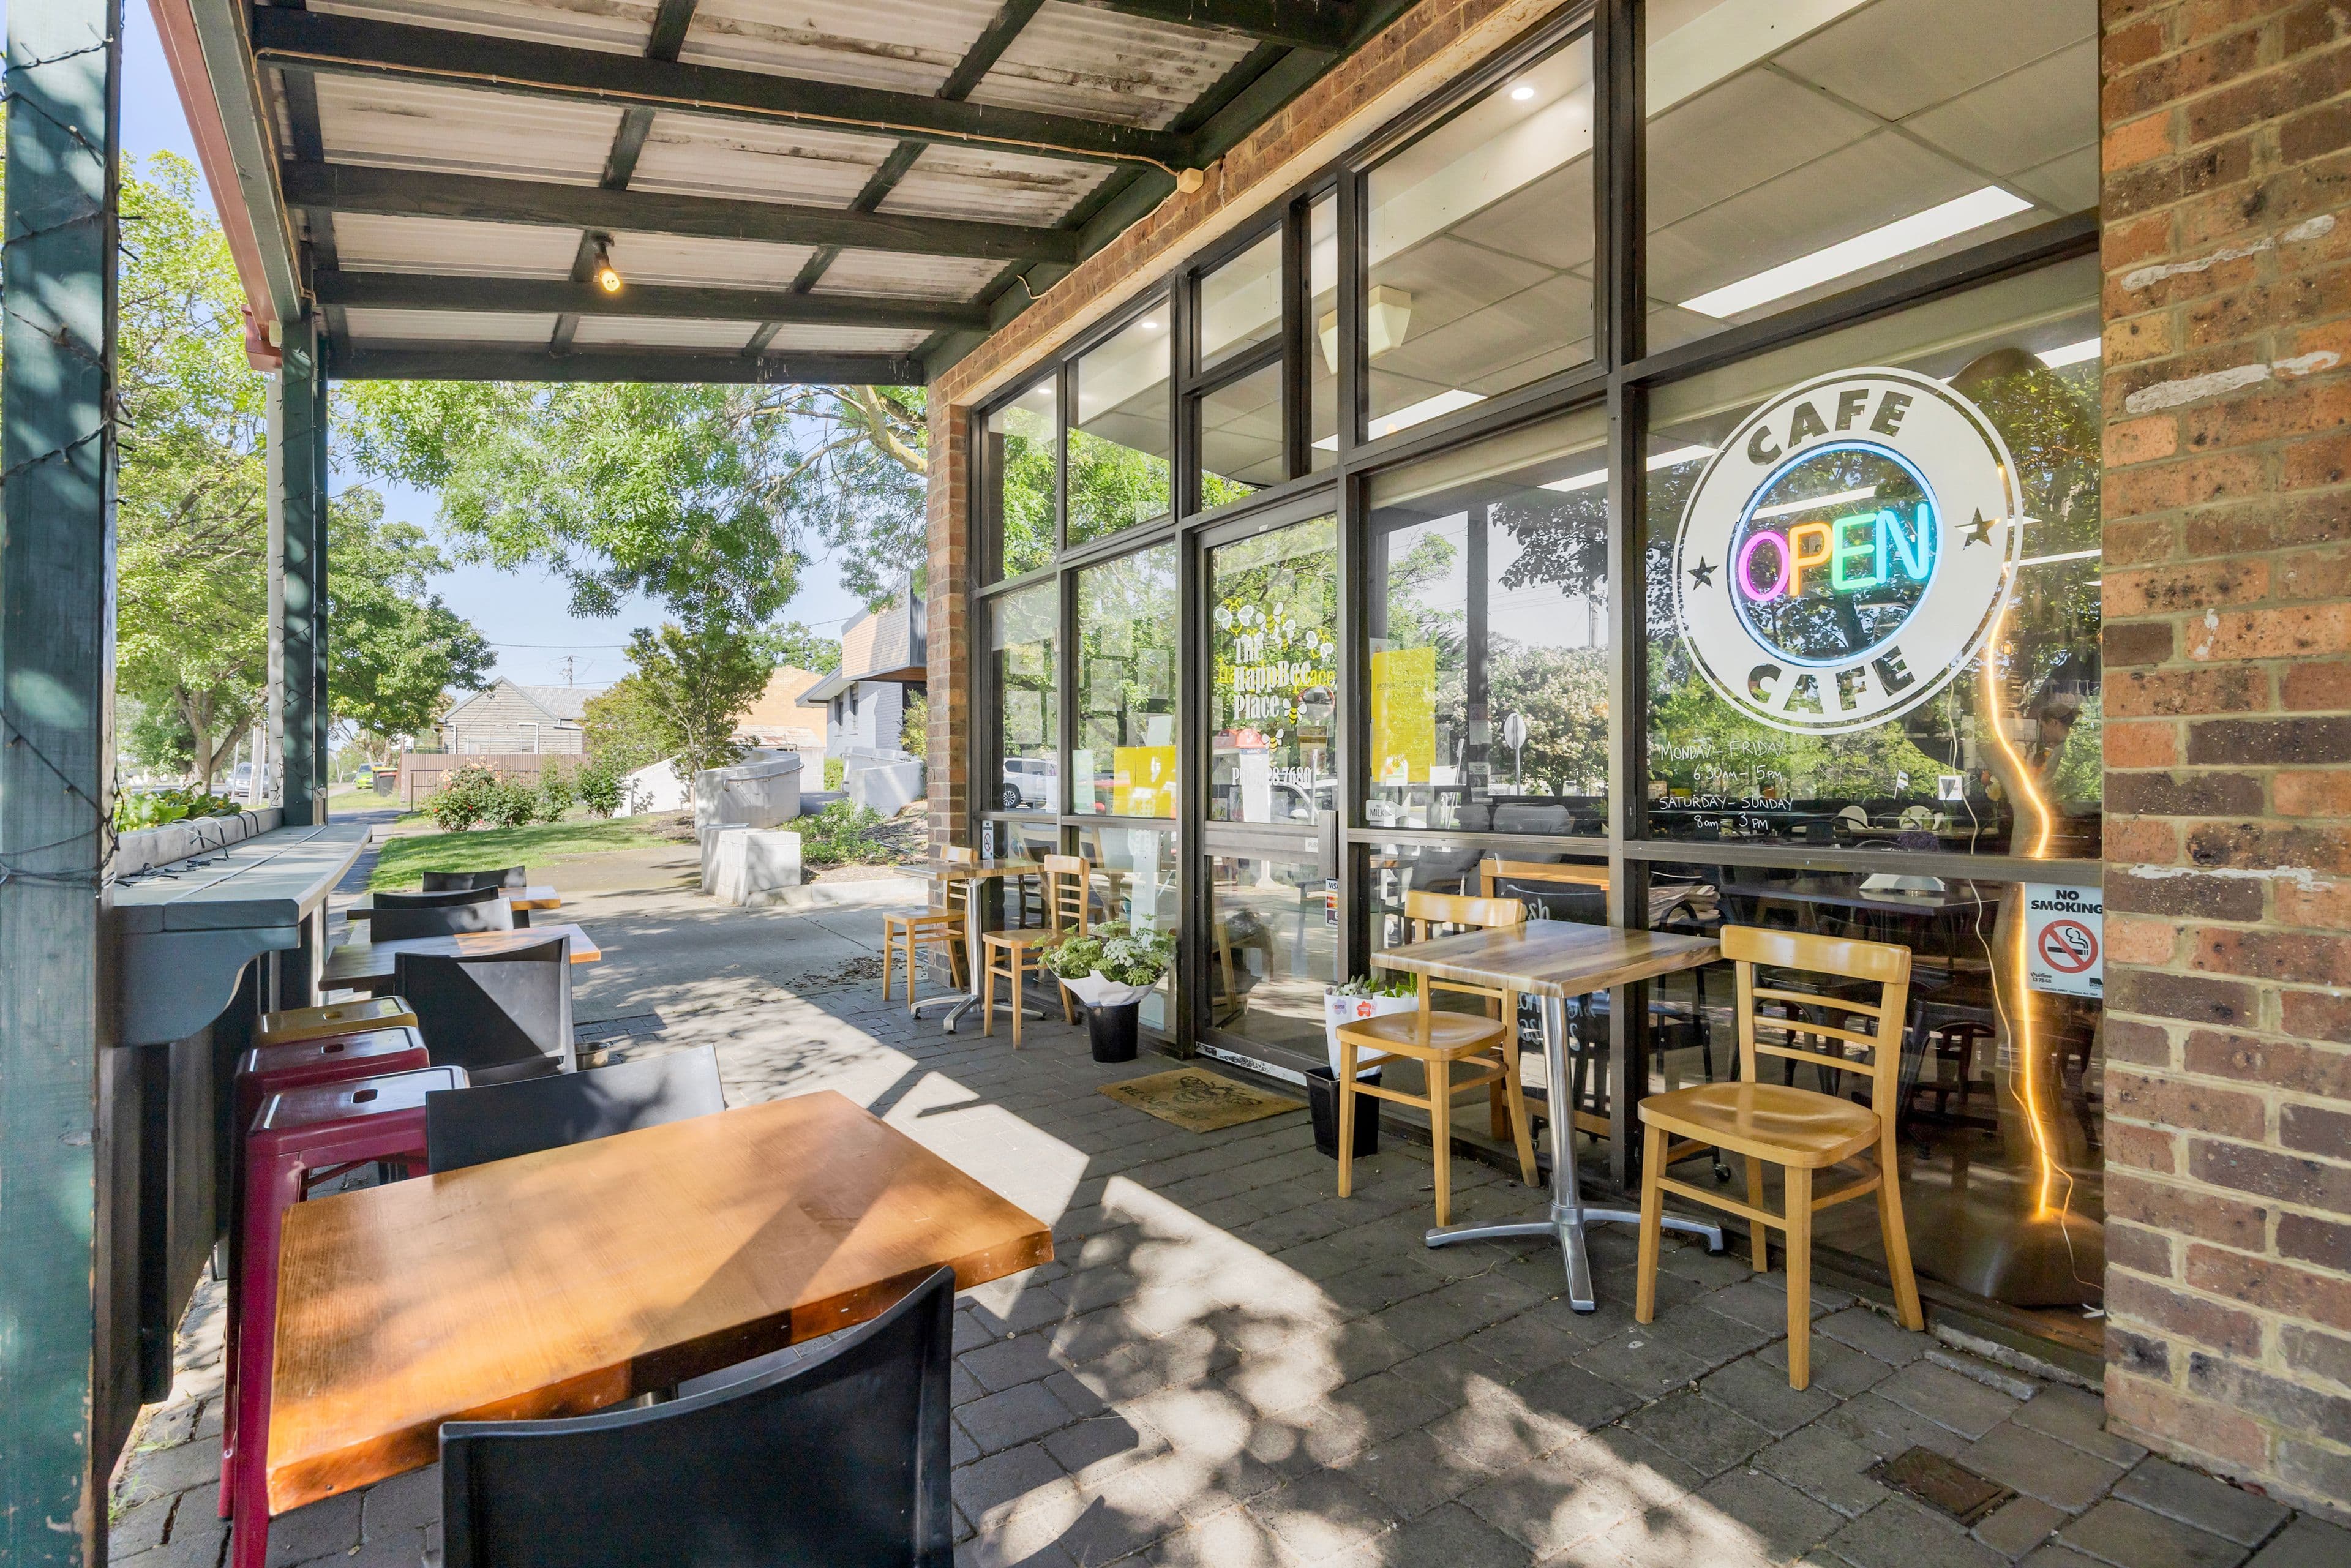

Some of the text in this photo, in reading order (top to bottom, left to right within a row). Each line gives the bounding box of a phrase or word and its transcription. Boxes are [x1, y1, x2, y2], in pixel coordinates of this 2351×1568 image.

[1747, 388, 1914, 466] CAFE
[1738, 502, 1930, 602] OPEN
[1233, 637, 1264, 664] The
[1747, 645, 1916, 715] CAFE
[1233, 694, 1280, 721] Place
[1660, 741, 1712, 762] MONDAY
[1730, 740, 1785, 758] FRIDAY
[1282, 767, 1312, 786] 7680
[1659, 797, 1727, 810] SATURDAY
[1741, 796, 1793, 811] SUNDAY
[1694, 815, 1719, 830] 8am
[2055, 890, 2079, 901] NO
[2031, 900, 2103, 914] SMOKING
